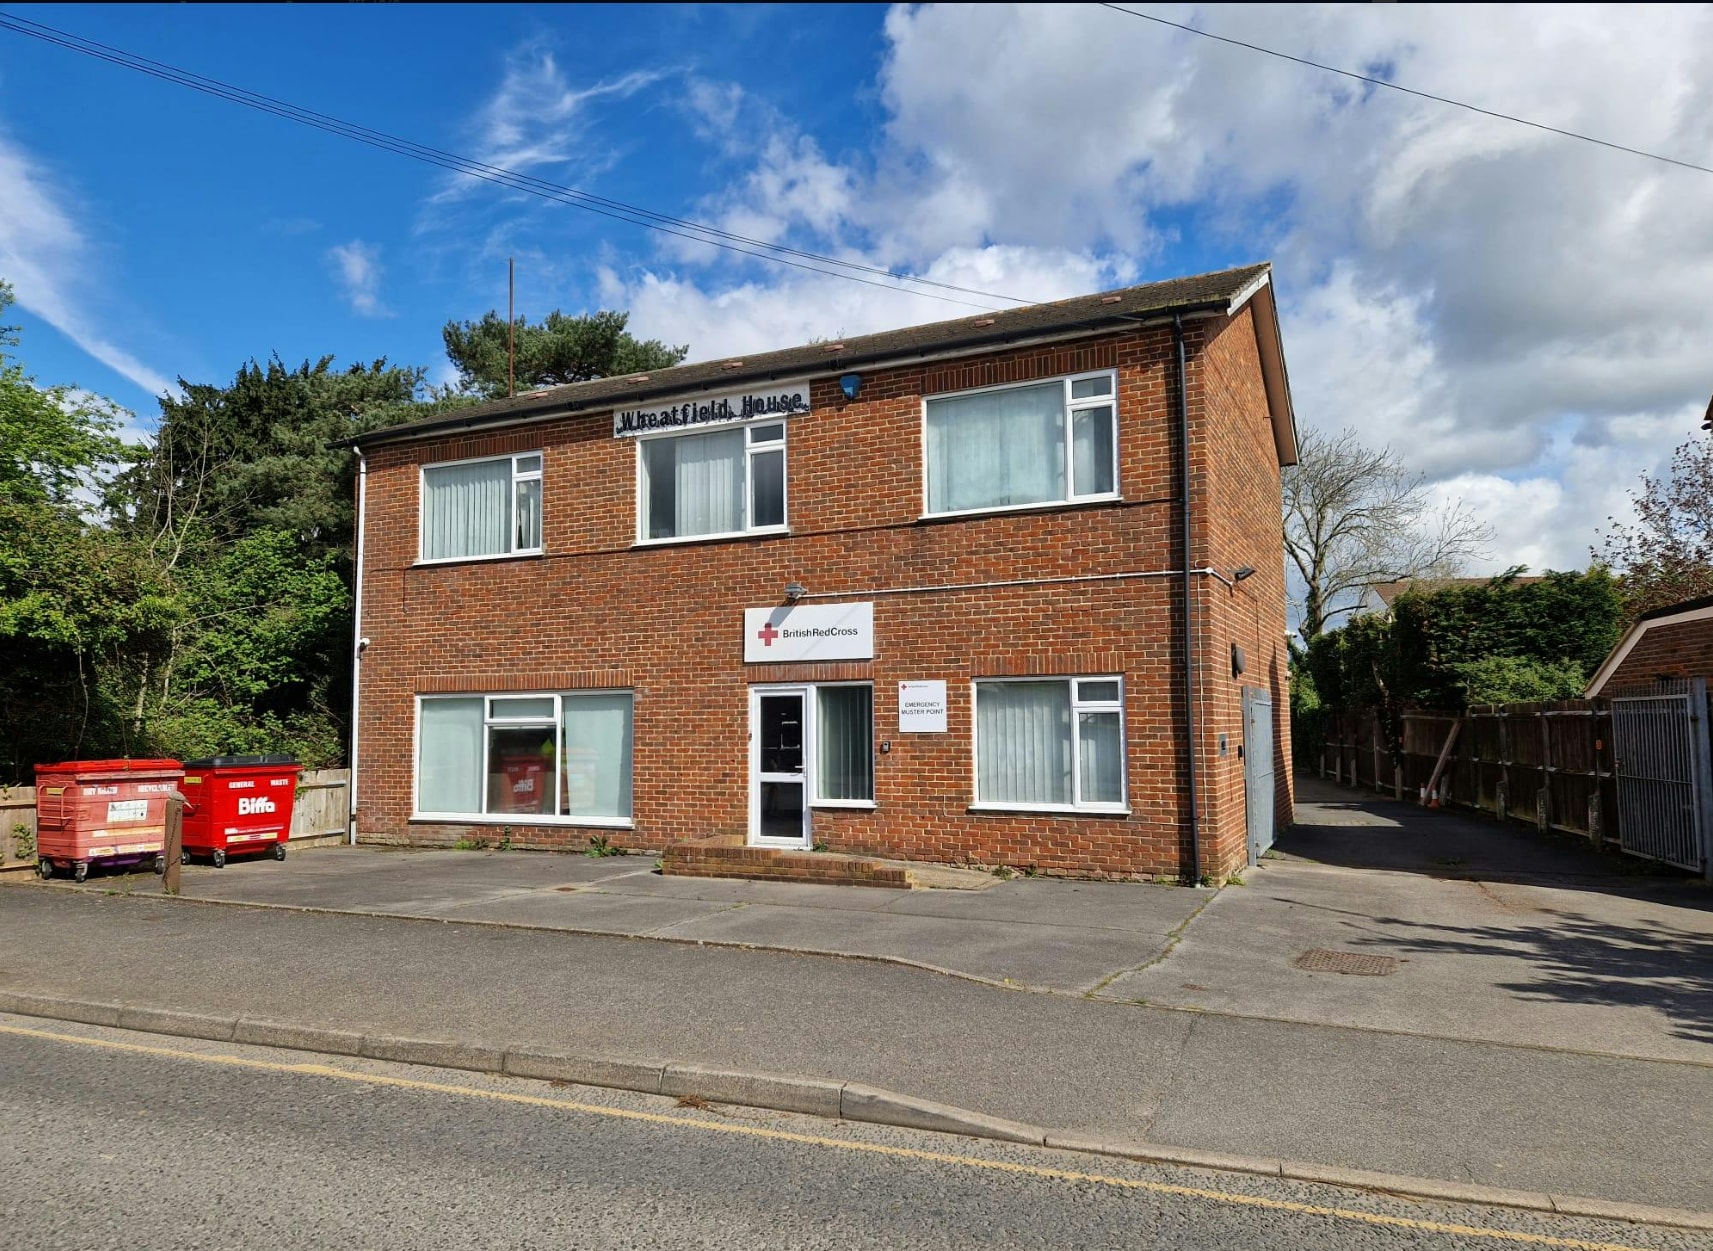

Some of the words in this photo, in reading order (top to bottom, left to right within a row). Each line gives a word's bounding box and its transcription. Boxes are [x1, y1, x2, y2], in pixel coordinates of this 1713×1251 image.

[621, 398, 729, 430] Wheatfield
[742, 393, 802, 417] House
[228, 780, 255, 789] GENERAL
[270, 778, 289, 787] WASTE
[238, 796, 276, 816] Biffa
